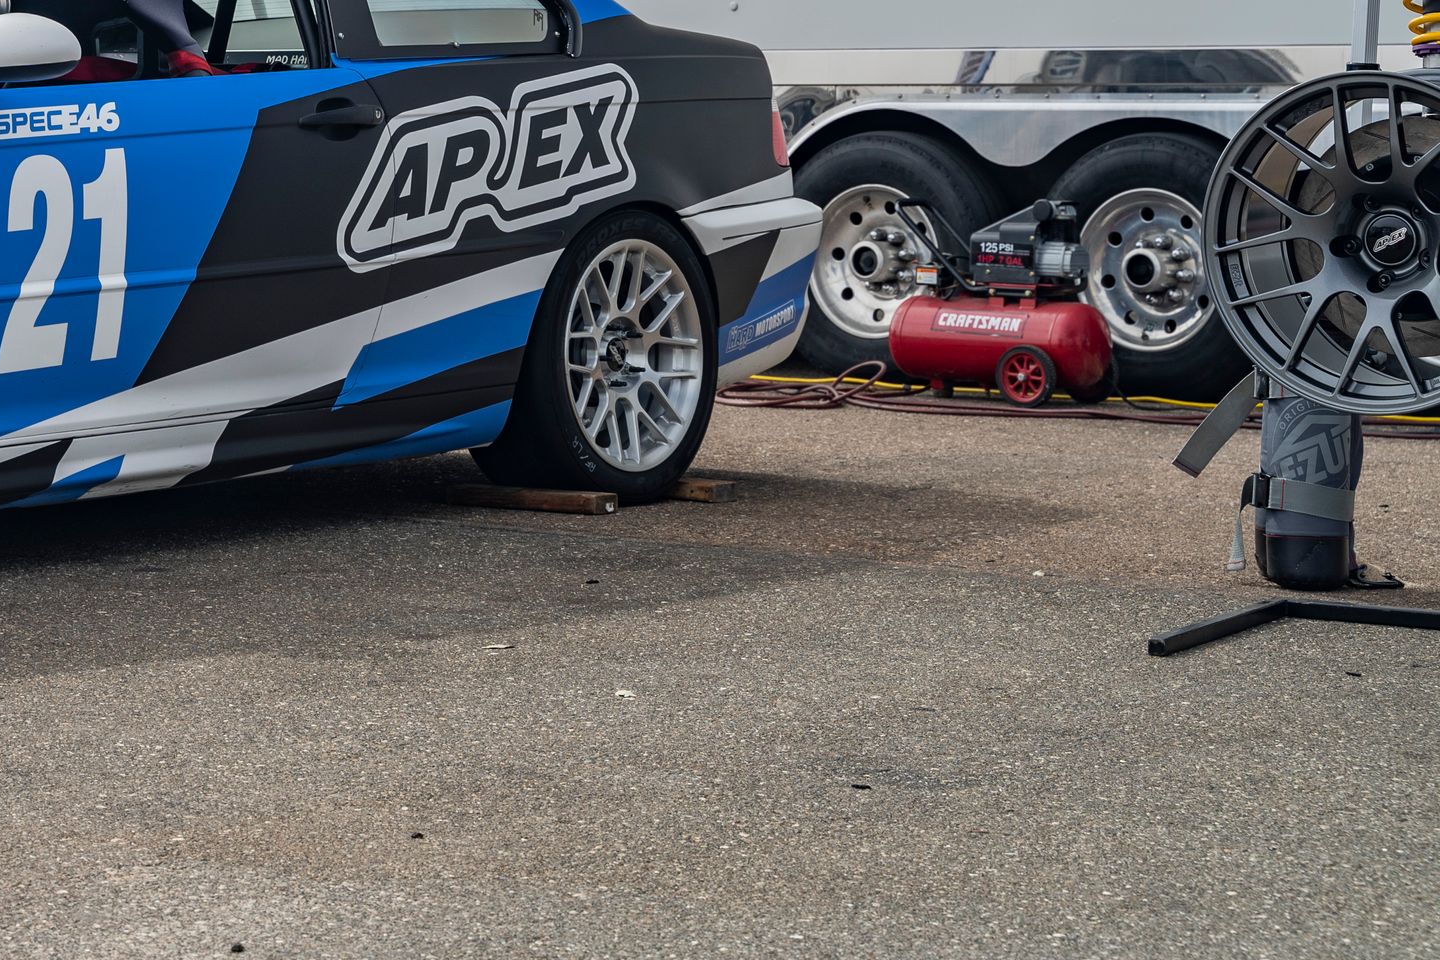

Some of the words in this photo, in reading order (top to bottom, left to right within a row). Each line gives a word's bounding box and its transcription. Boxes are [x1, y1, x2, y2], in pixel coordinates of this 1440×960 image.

[266, 55, 289, 65] MAD
[360, 88, 620, 238] APEX
[979, 242, 998, 254] 125
[998, 244, 1014, 253] PSI
[1375, 229, 1406, 251] APEX
[998, 255, 1005, 264] 7
[1005, 256, 1024, 266] GAL
[754, 304, 795, 337] MOTORSPORT
[937, 312, 1023, 332] CRAFTSMAN
[1279, 400, 1320, 430] ORIGI
